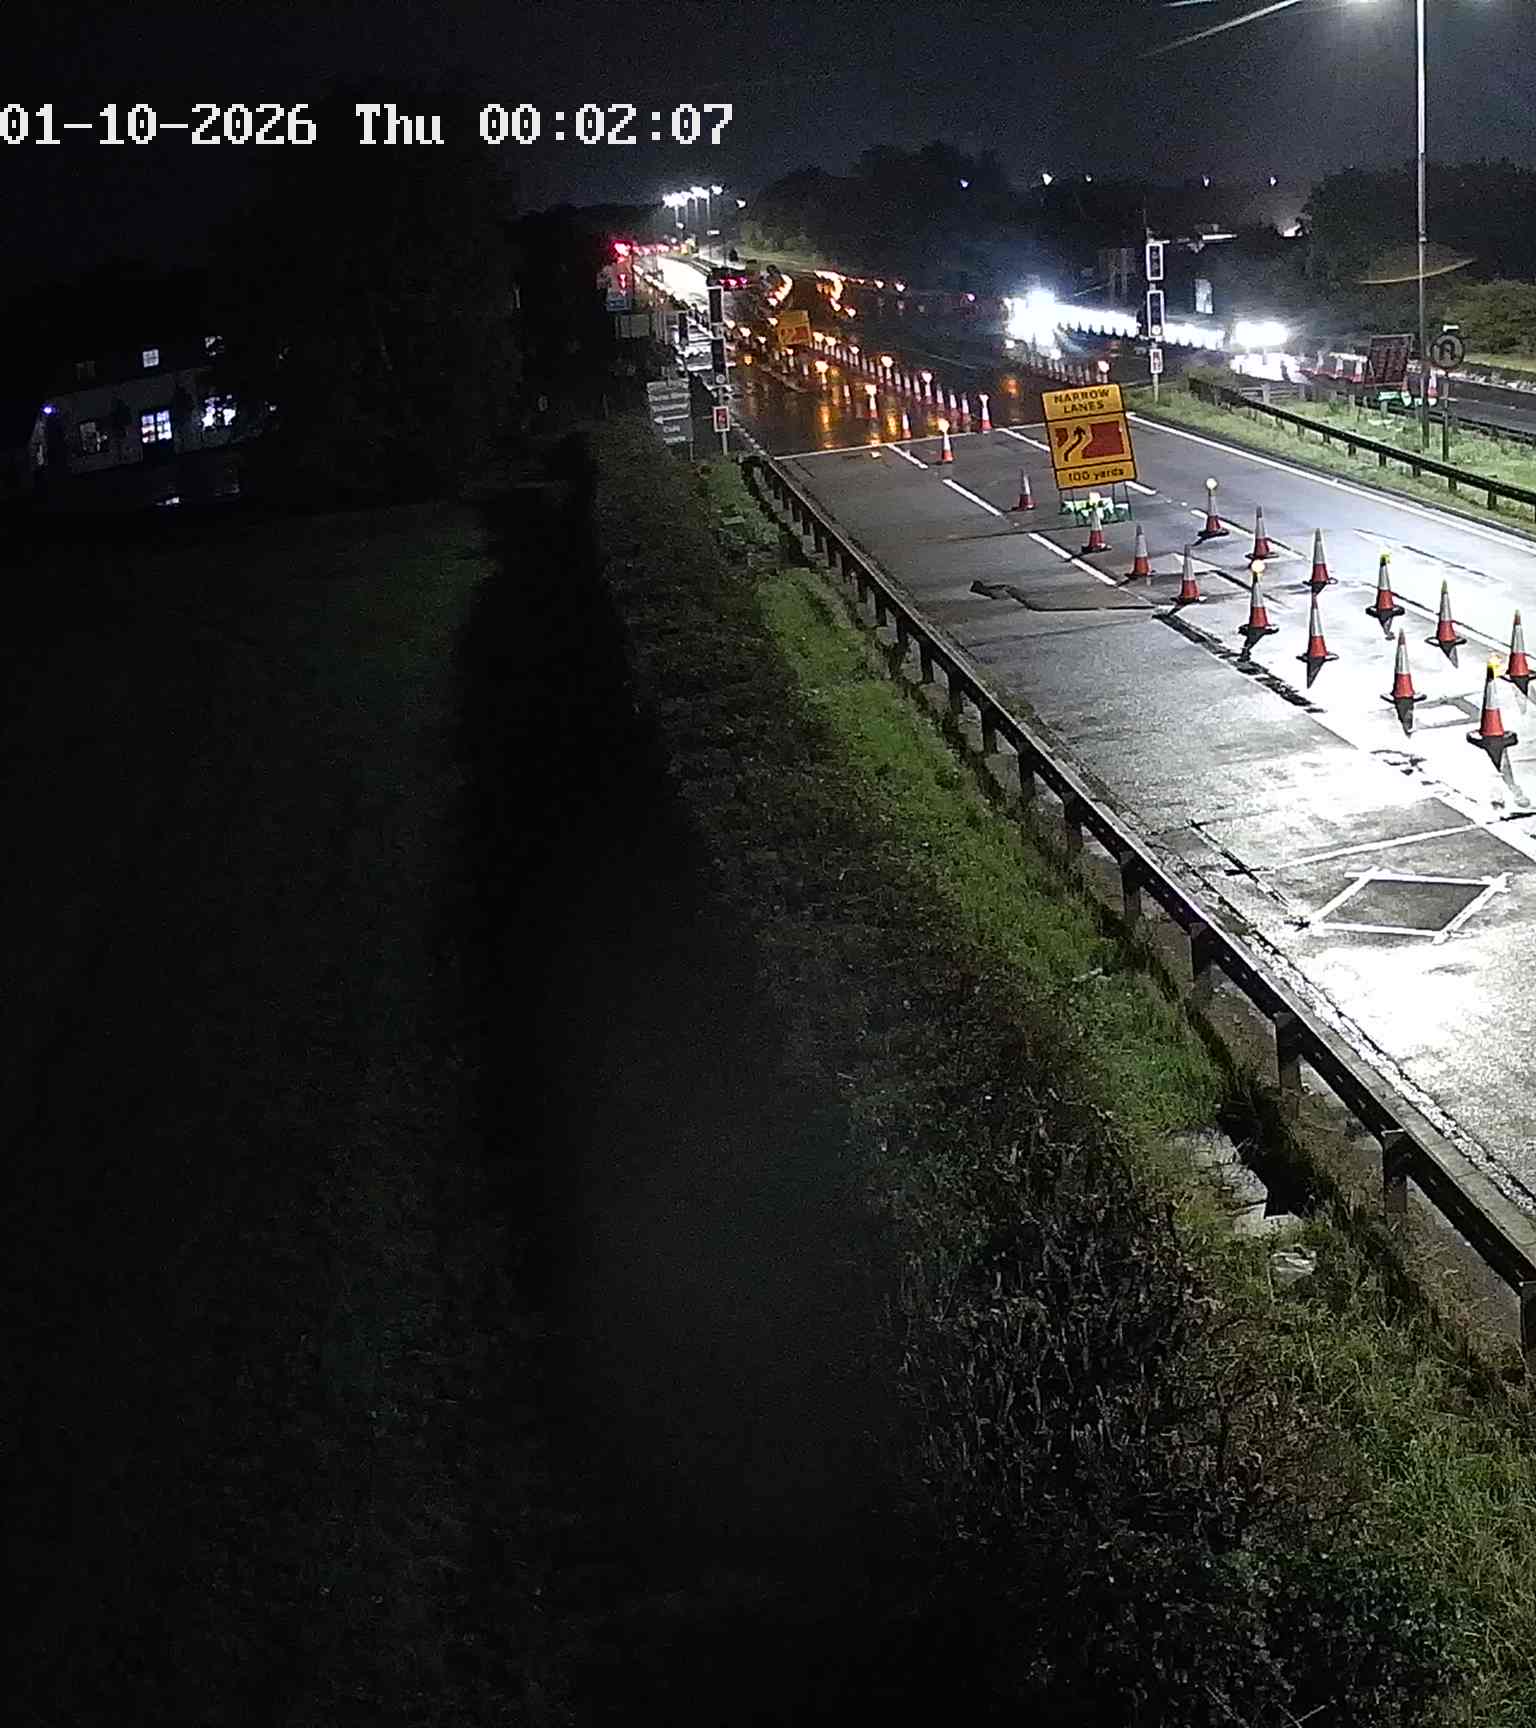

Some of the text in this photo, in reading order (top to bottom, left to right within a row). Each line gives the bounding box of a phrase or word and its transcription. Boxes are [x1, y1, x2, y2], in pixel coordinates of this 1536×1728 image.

[1055, 389, 1109, 403] NARROW
[1064, 400, 1104, 413] LANES
[1069, 468, 1123, 481] 100 yards
